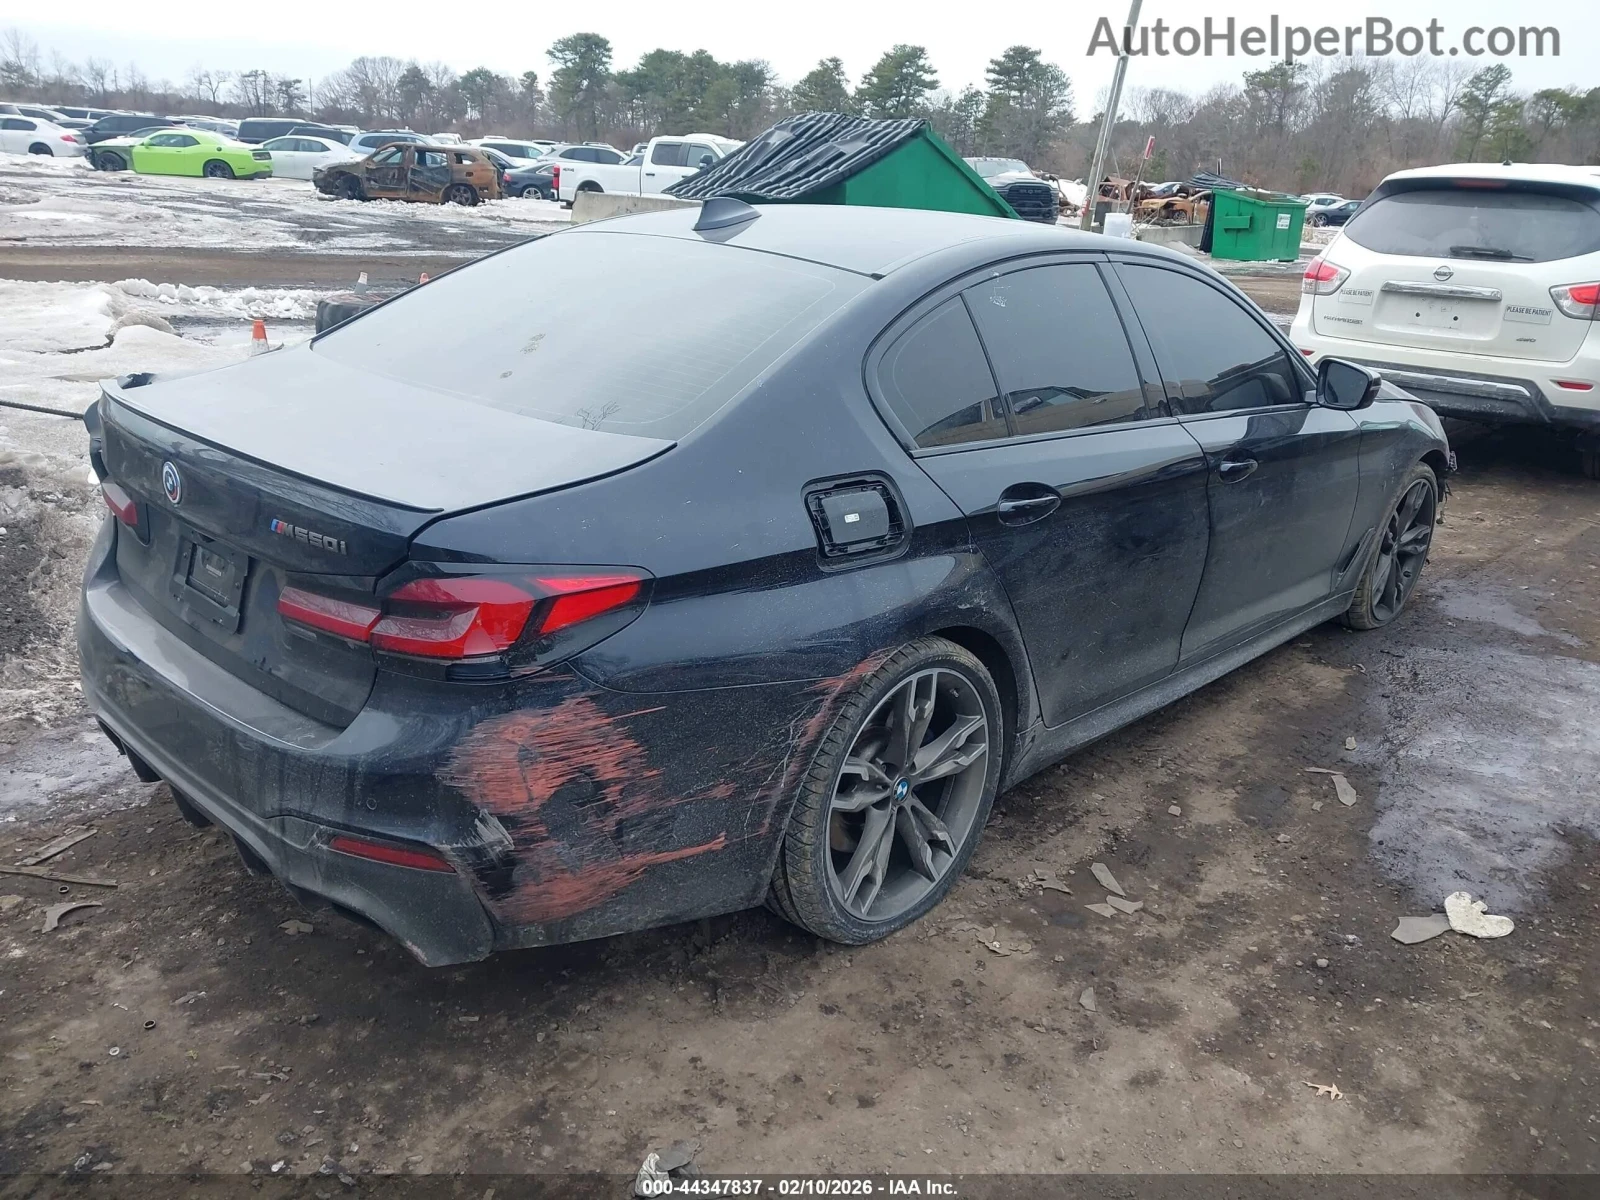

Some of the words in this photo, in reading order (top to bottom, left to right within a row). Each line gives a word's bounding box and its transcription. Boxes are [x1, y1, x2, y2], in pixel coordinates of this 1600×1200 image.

[1506, 306, 1525, 314] PLEASE
[1525, 307, 1532, 315] BE
[1532, 308, 1552, 316] PATIENT
